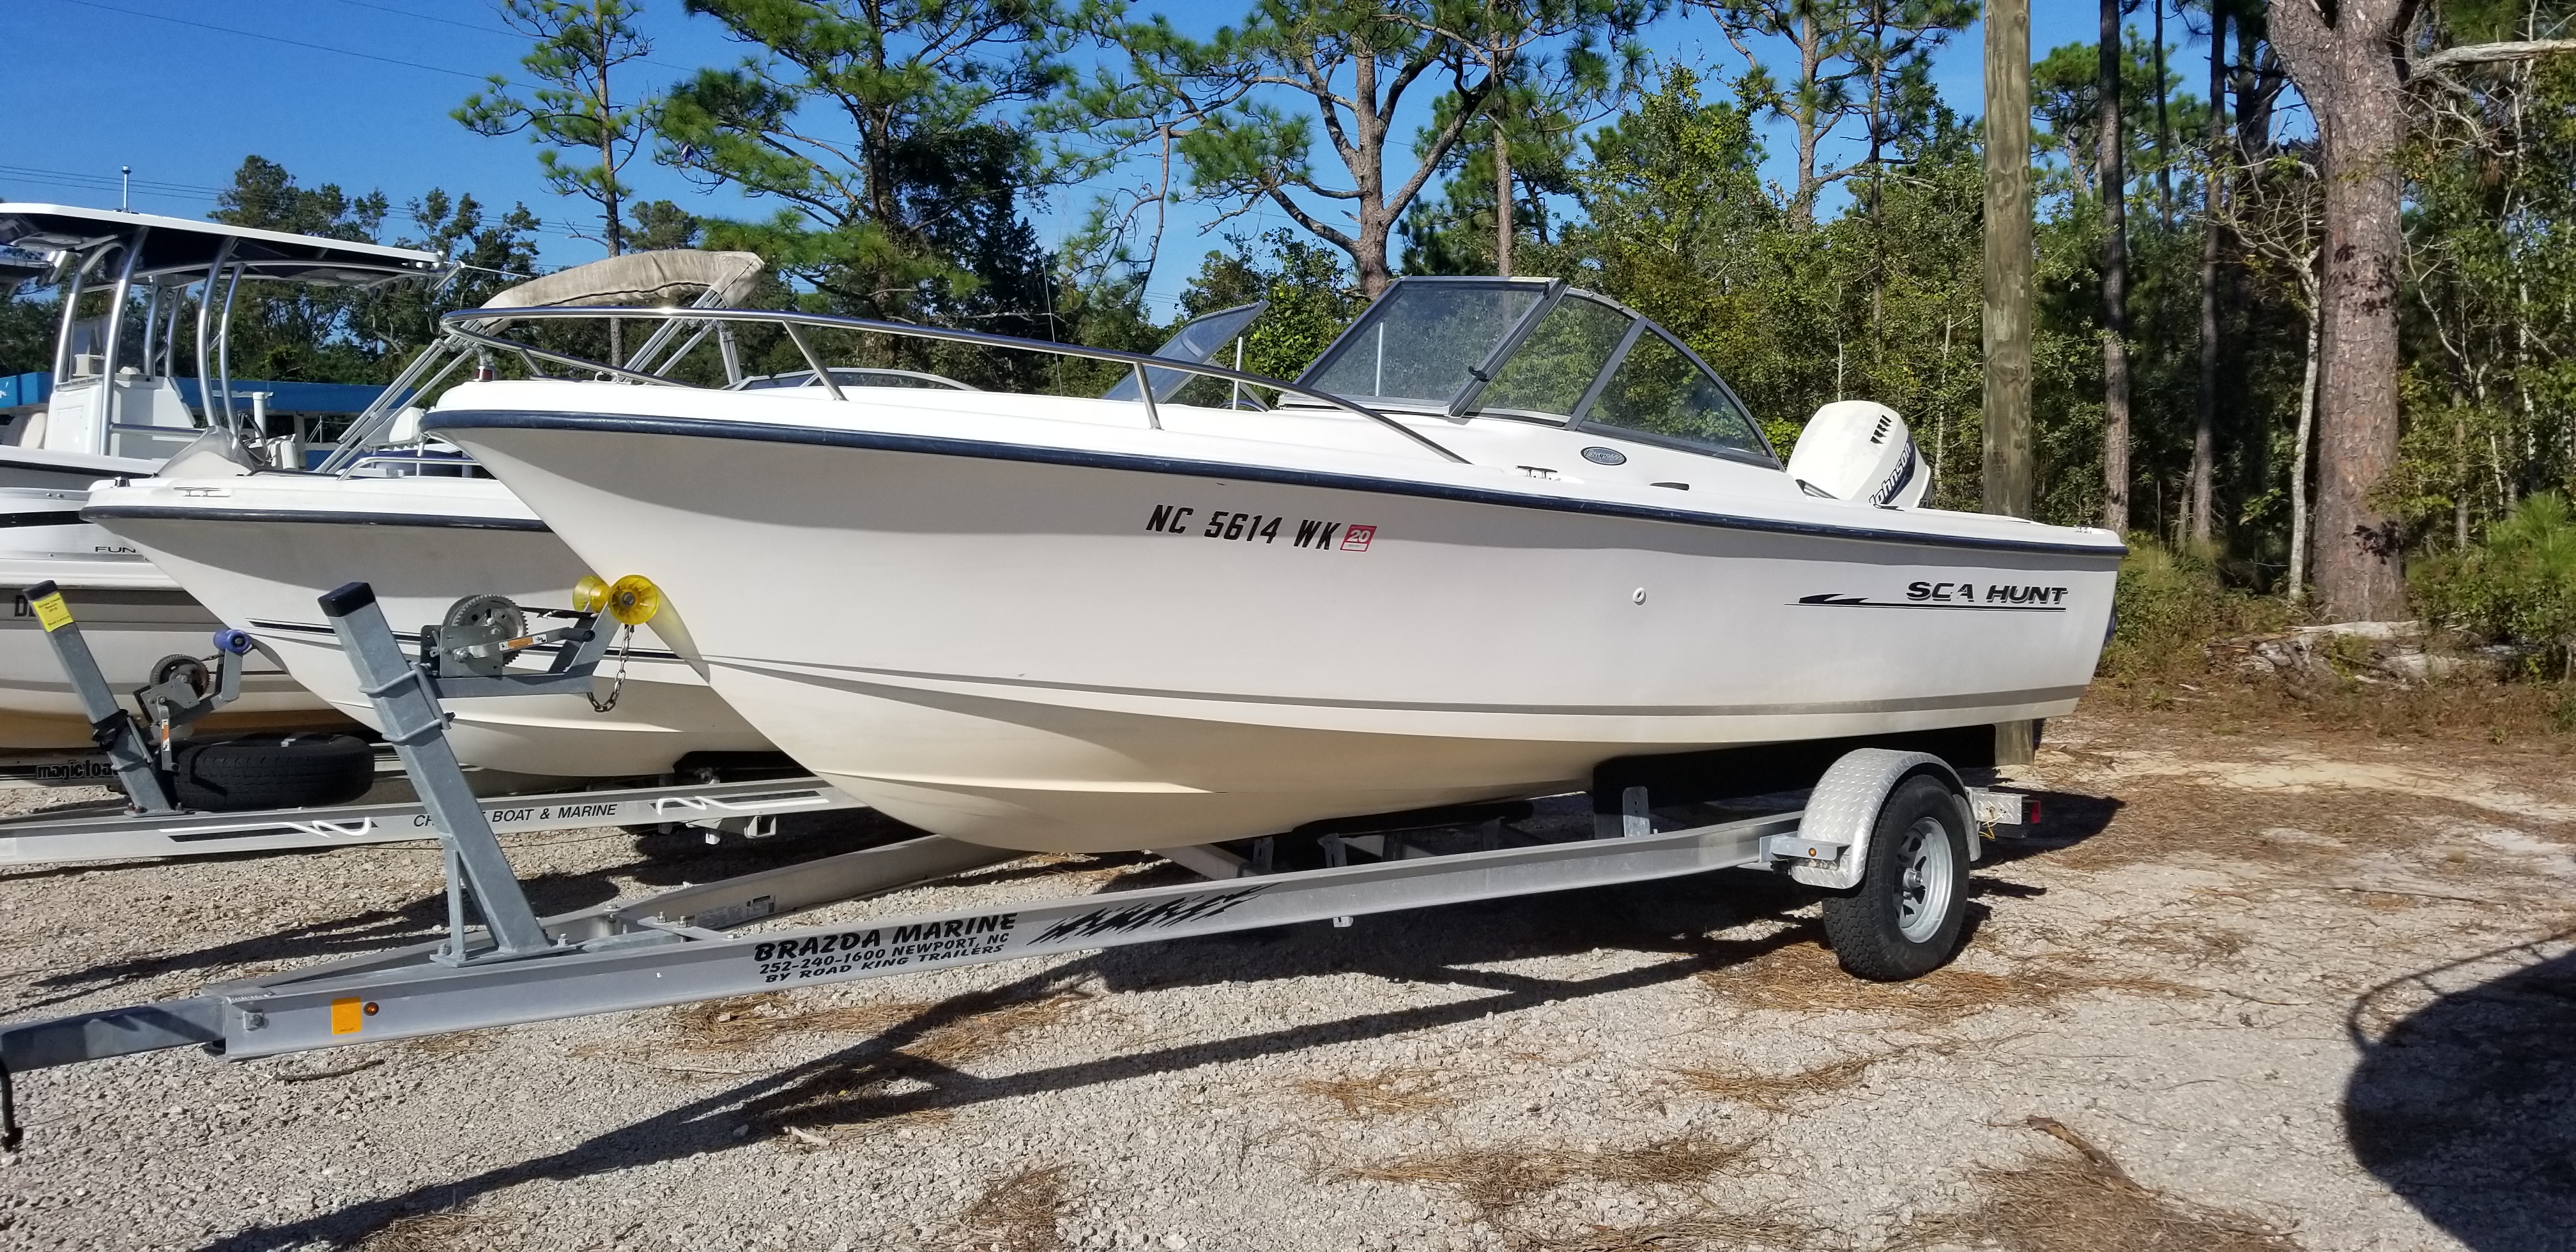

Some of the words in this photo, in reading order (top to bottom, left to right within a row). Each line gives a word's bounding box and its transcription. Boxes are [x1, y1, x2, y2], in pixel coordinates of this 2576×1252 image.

[1869, 442, 1911, 505] Johnson
[1146, 504, 1193, 534] NC
[1204, 510, 1282, 544] 5614
[1293, 519, 1341, 550] WK
[1346, 530, 1371, 542] 20
[1986, 585, 2068, 604] HUNT
[491, 809, 534, 823] BOAT
[539, 808, 550, 820] &
[558, 804, 617, 819] MARINE
[754, 929, 880, 962] BRAZDA
[892, 913, 1018, 944] MARINE
[759, 949, 886, 974] 252-240-1600
[892, 937, 979, 956] NEWPORT,
[987, 933, 1009, 945] NC
[765, 972, 791, 982] BY
[799, 965, 852, 978] ROAD
[861, 957, 909, 970] KING
[918, 944, 1004, 963] TRAILERS
